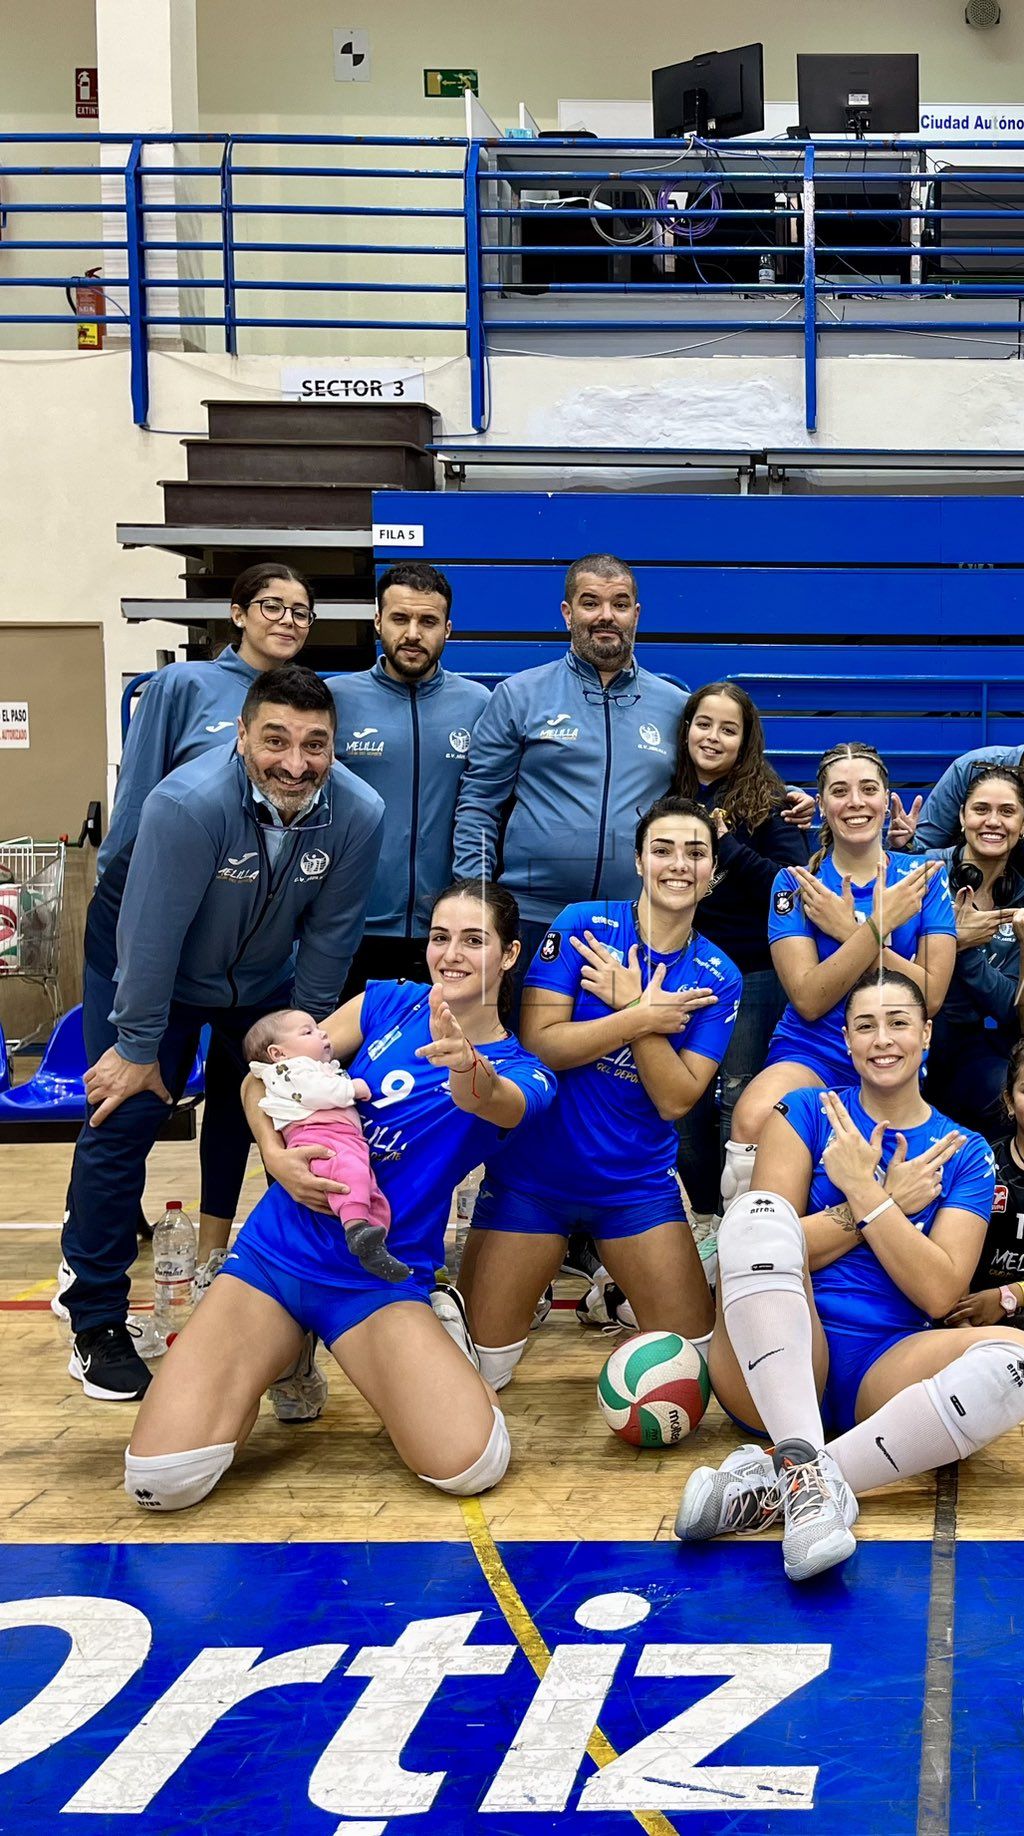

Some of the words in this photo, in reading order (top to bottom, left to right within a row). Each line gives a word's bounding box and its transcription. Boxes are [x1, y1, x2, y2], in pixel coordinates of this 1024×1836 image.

[920, 115, 969, 130] Ciudad
[301, 380, 383, 397] SECTOR
[393, 381, 405, 397] 3
[379, 529, 405, 540] FILA
[408, 530, 415, 540] 5
[2, 709, 10, 722] EL
[11, 709, 27, 722] PASO
[346, 741, 385, 752] MELILLA
[613, 1068, 640, 1084] DEPO
[371, 1070, 415, 1109] 9
[668, 1409, 683, 1441] molte
